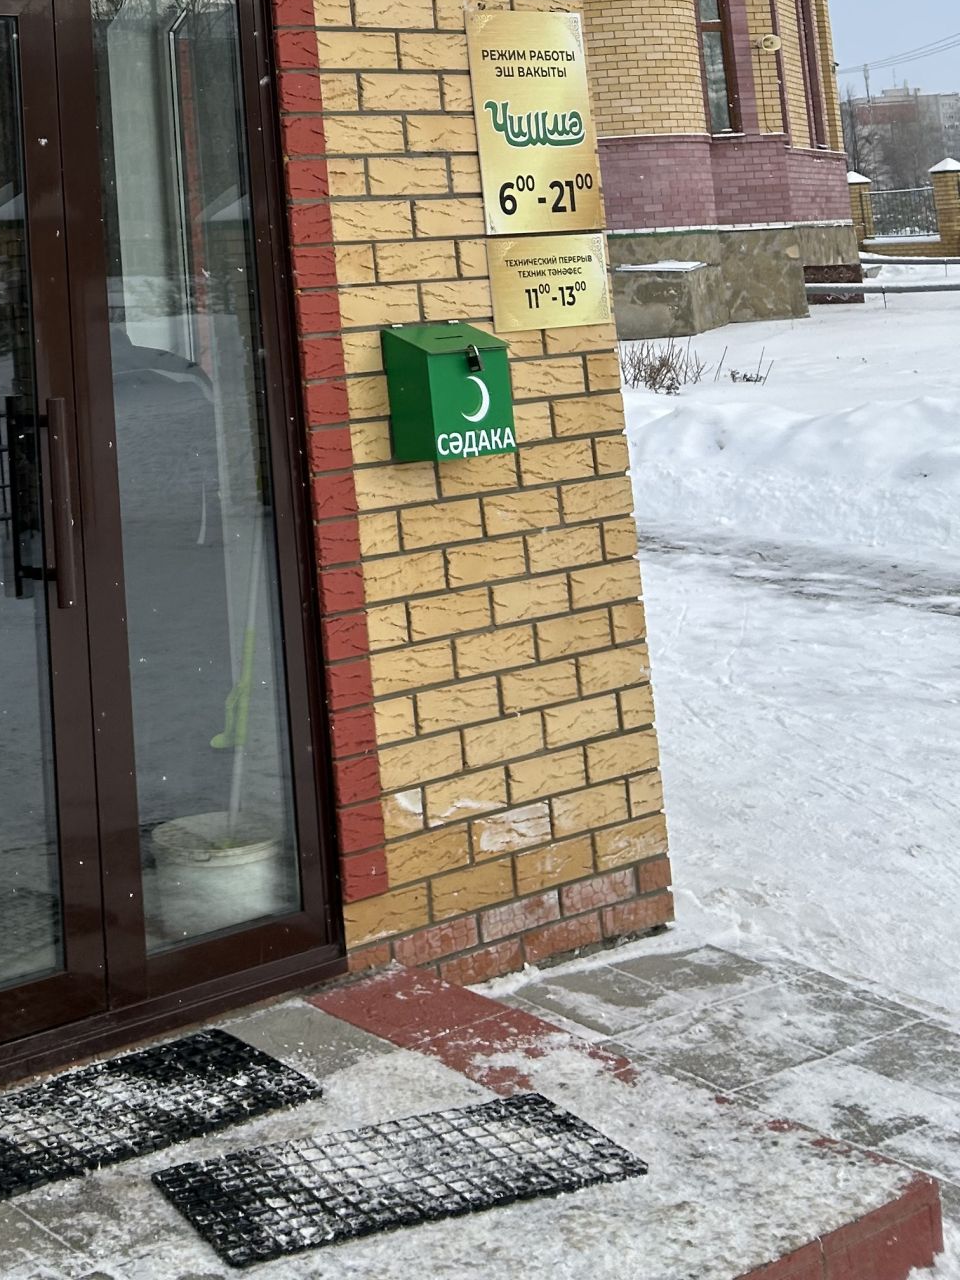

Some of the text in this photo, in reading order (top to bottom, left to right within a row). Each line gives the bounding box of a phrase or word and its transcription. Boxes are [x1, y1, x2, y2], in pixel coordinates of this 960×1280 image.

[481, 49, 575, 61] РЕЖИМ РАБОТЫ
[495, 66, 567, 77] ЭШ ВАКЫТЫ
[484, 100, 585, 147] Чишмә
[505, 255, 592, 267] ТЕХНИЧЕСКИЙ ПЕРЕРЫВ
[518, 267, 582, 278] ТЕХНИК ТӘНӘФЕС
[437, 427, 516, 457] СӘДАКА
